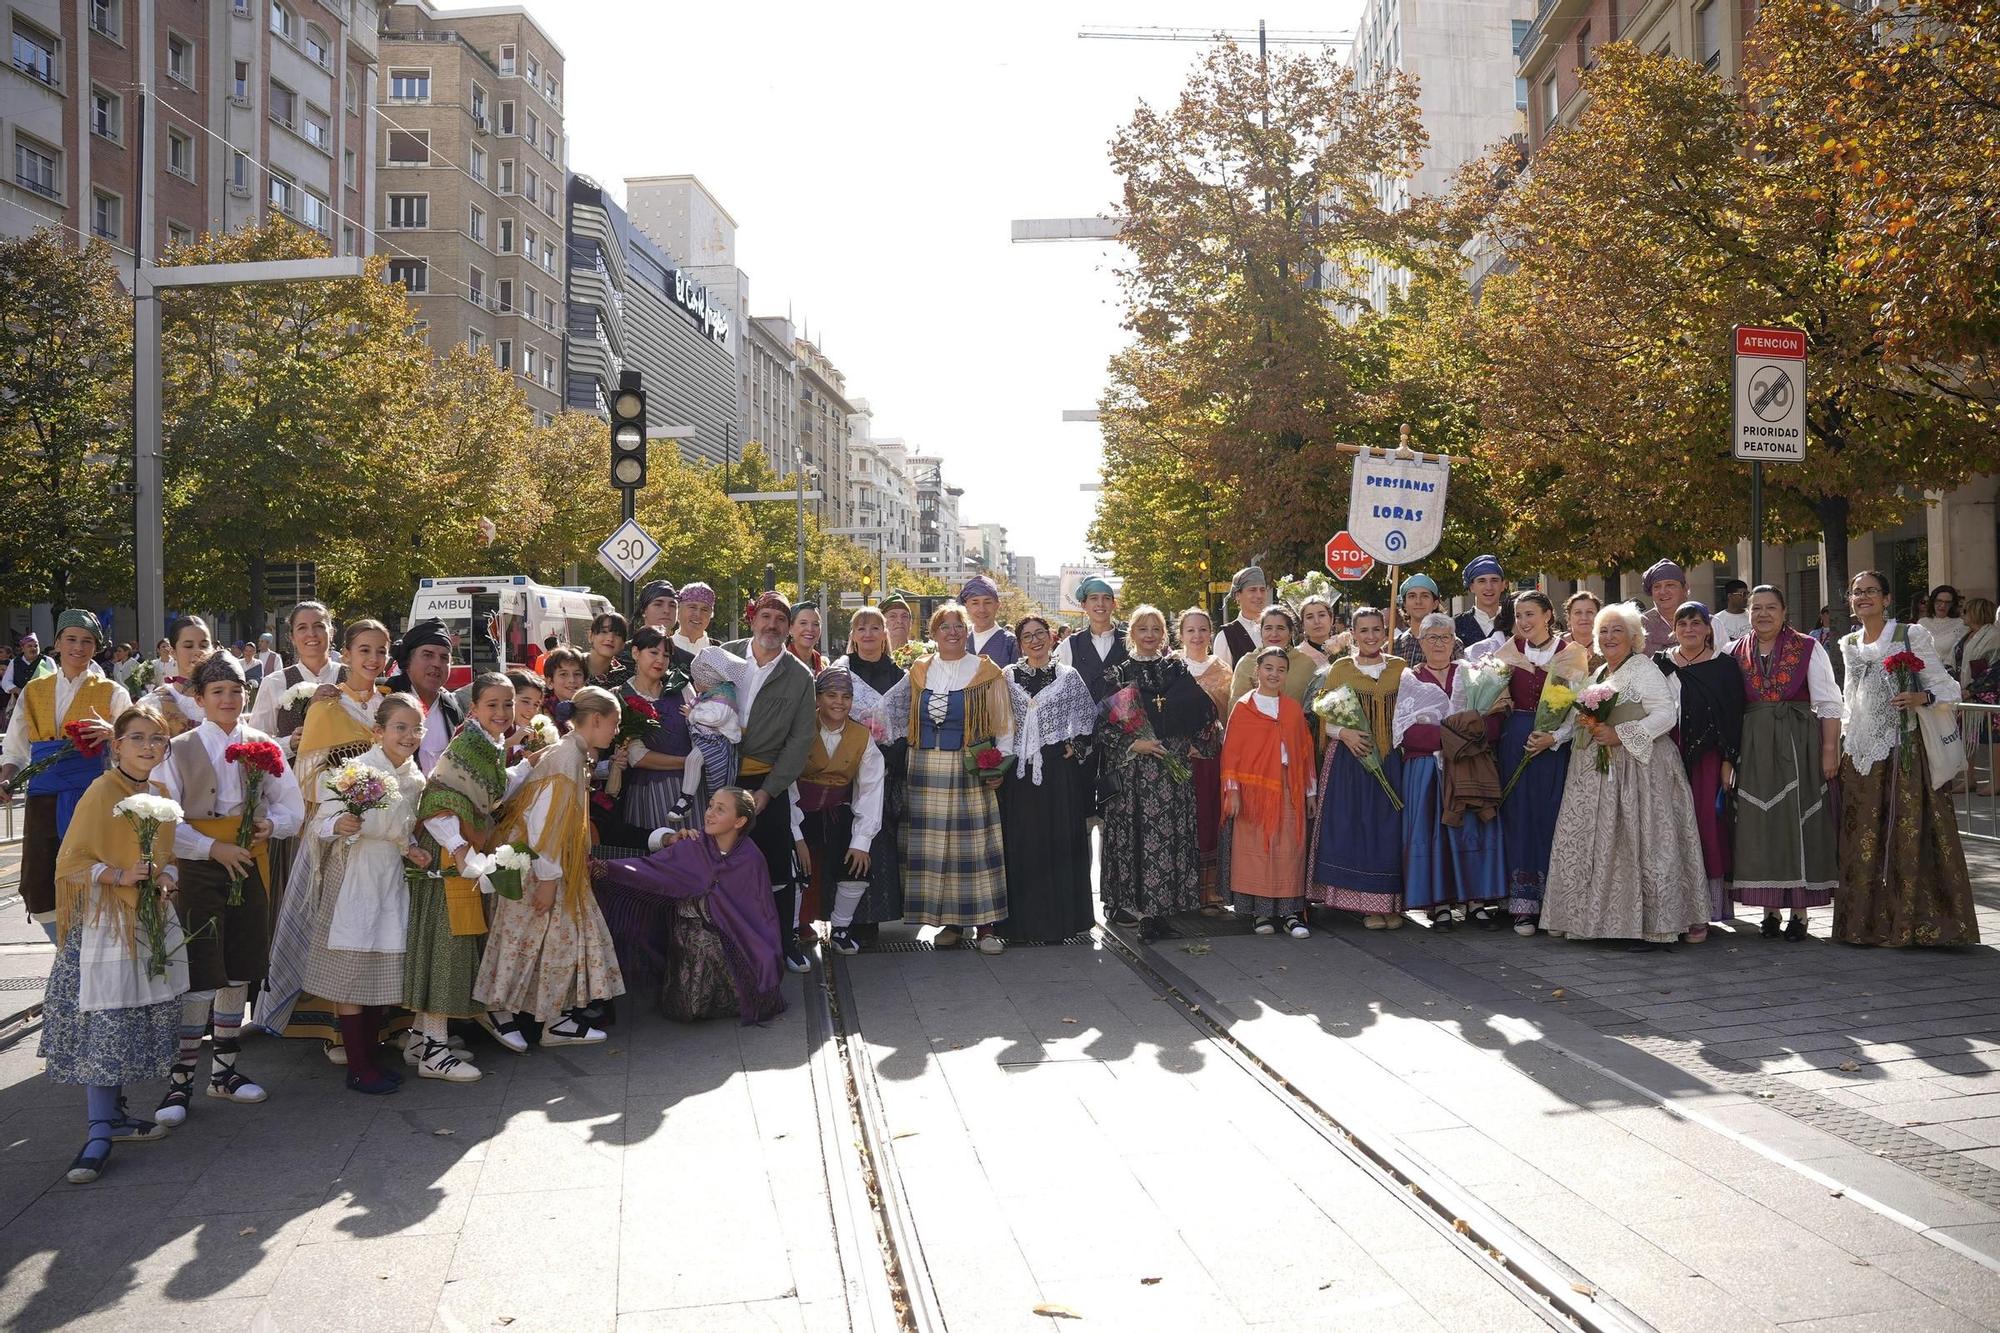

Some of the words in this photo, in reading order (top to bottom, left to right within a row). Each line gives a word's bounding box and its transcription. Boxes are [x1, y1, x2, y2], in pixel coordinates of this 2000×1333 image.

[1744, 336, 1798, 350] ATENCIÓN
[1743, 426, 1799, 438] PRIORIDAD
[1744, 442, 1798, 453] PEATONAL
[1366, 475, 1435, 493] PERSIANAS
[1373, 505, 1423, 521] LORAS
[617, 539, 644, 560] 30
